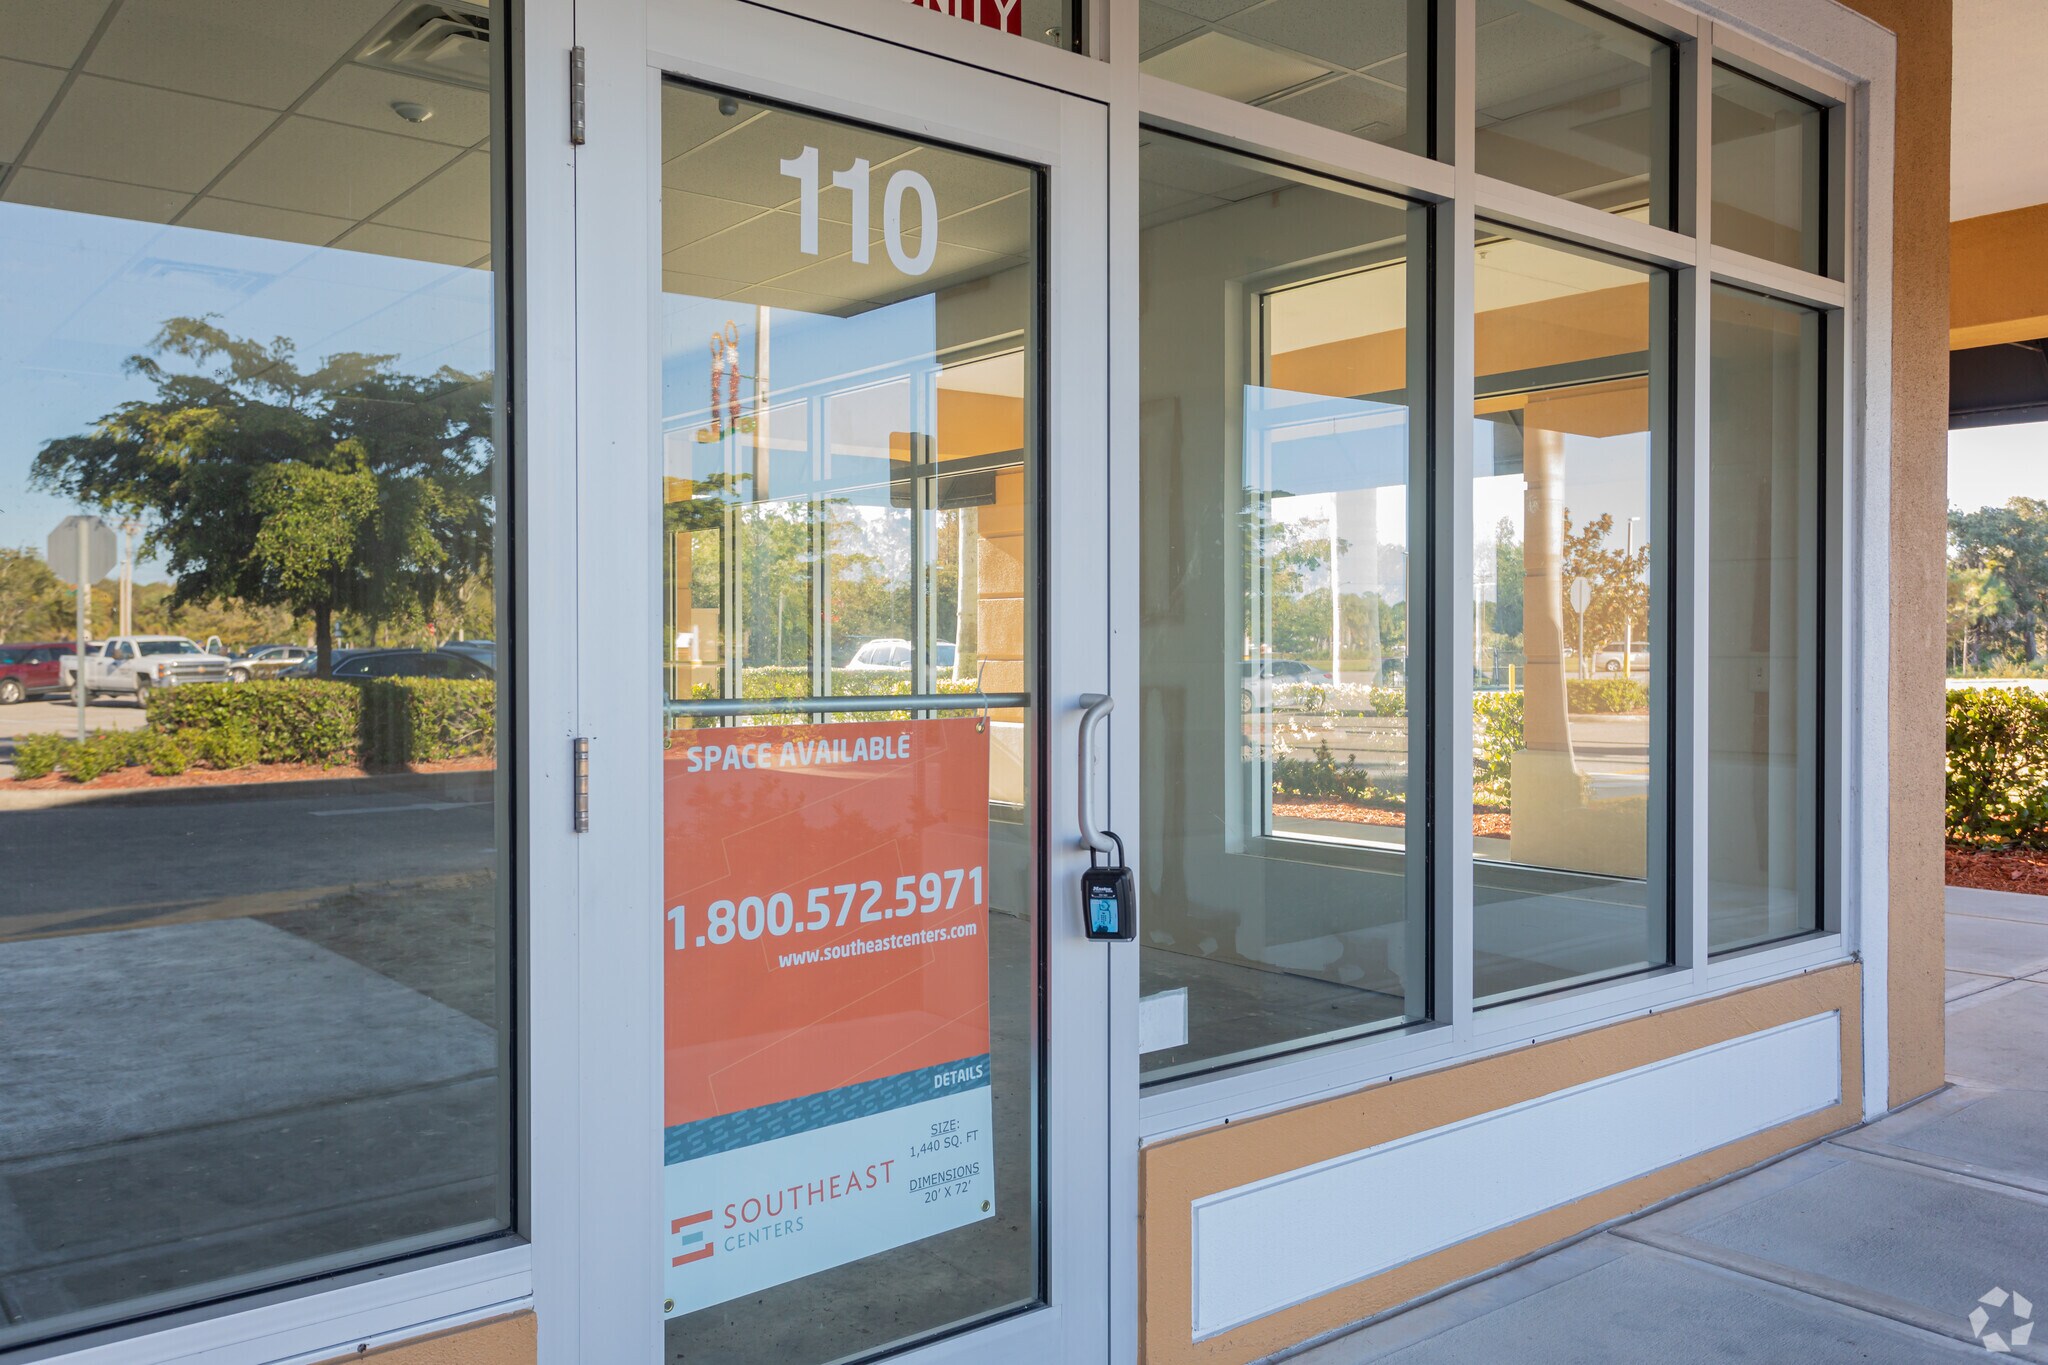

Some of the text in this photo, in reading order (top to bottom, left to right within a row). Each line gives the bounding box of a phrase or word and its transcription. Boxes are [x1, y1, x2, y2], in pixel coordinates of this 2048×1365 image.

[780, 145, 938, 276] 110
[687, 735, 910, 773] SPACE AVAILABLE
[667, 866, 983, 950] 1.800.572.5971
[778, 921, 977, 968] www.southeastcenters.com
[934, 1065, 983, 1089] DETAILS
[910, 1129, 979, 1158] 1,440 SQ. FT
[930, 1119, 960, 1136] SIZE:
[723, 1159, 895, 1229] SOUTHEAST
[909, 1162, 980, 1192] DIMENSIONS
[723, 1216, 805, 1252] CENTERS
